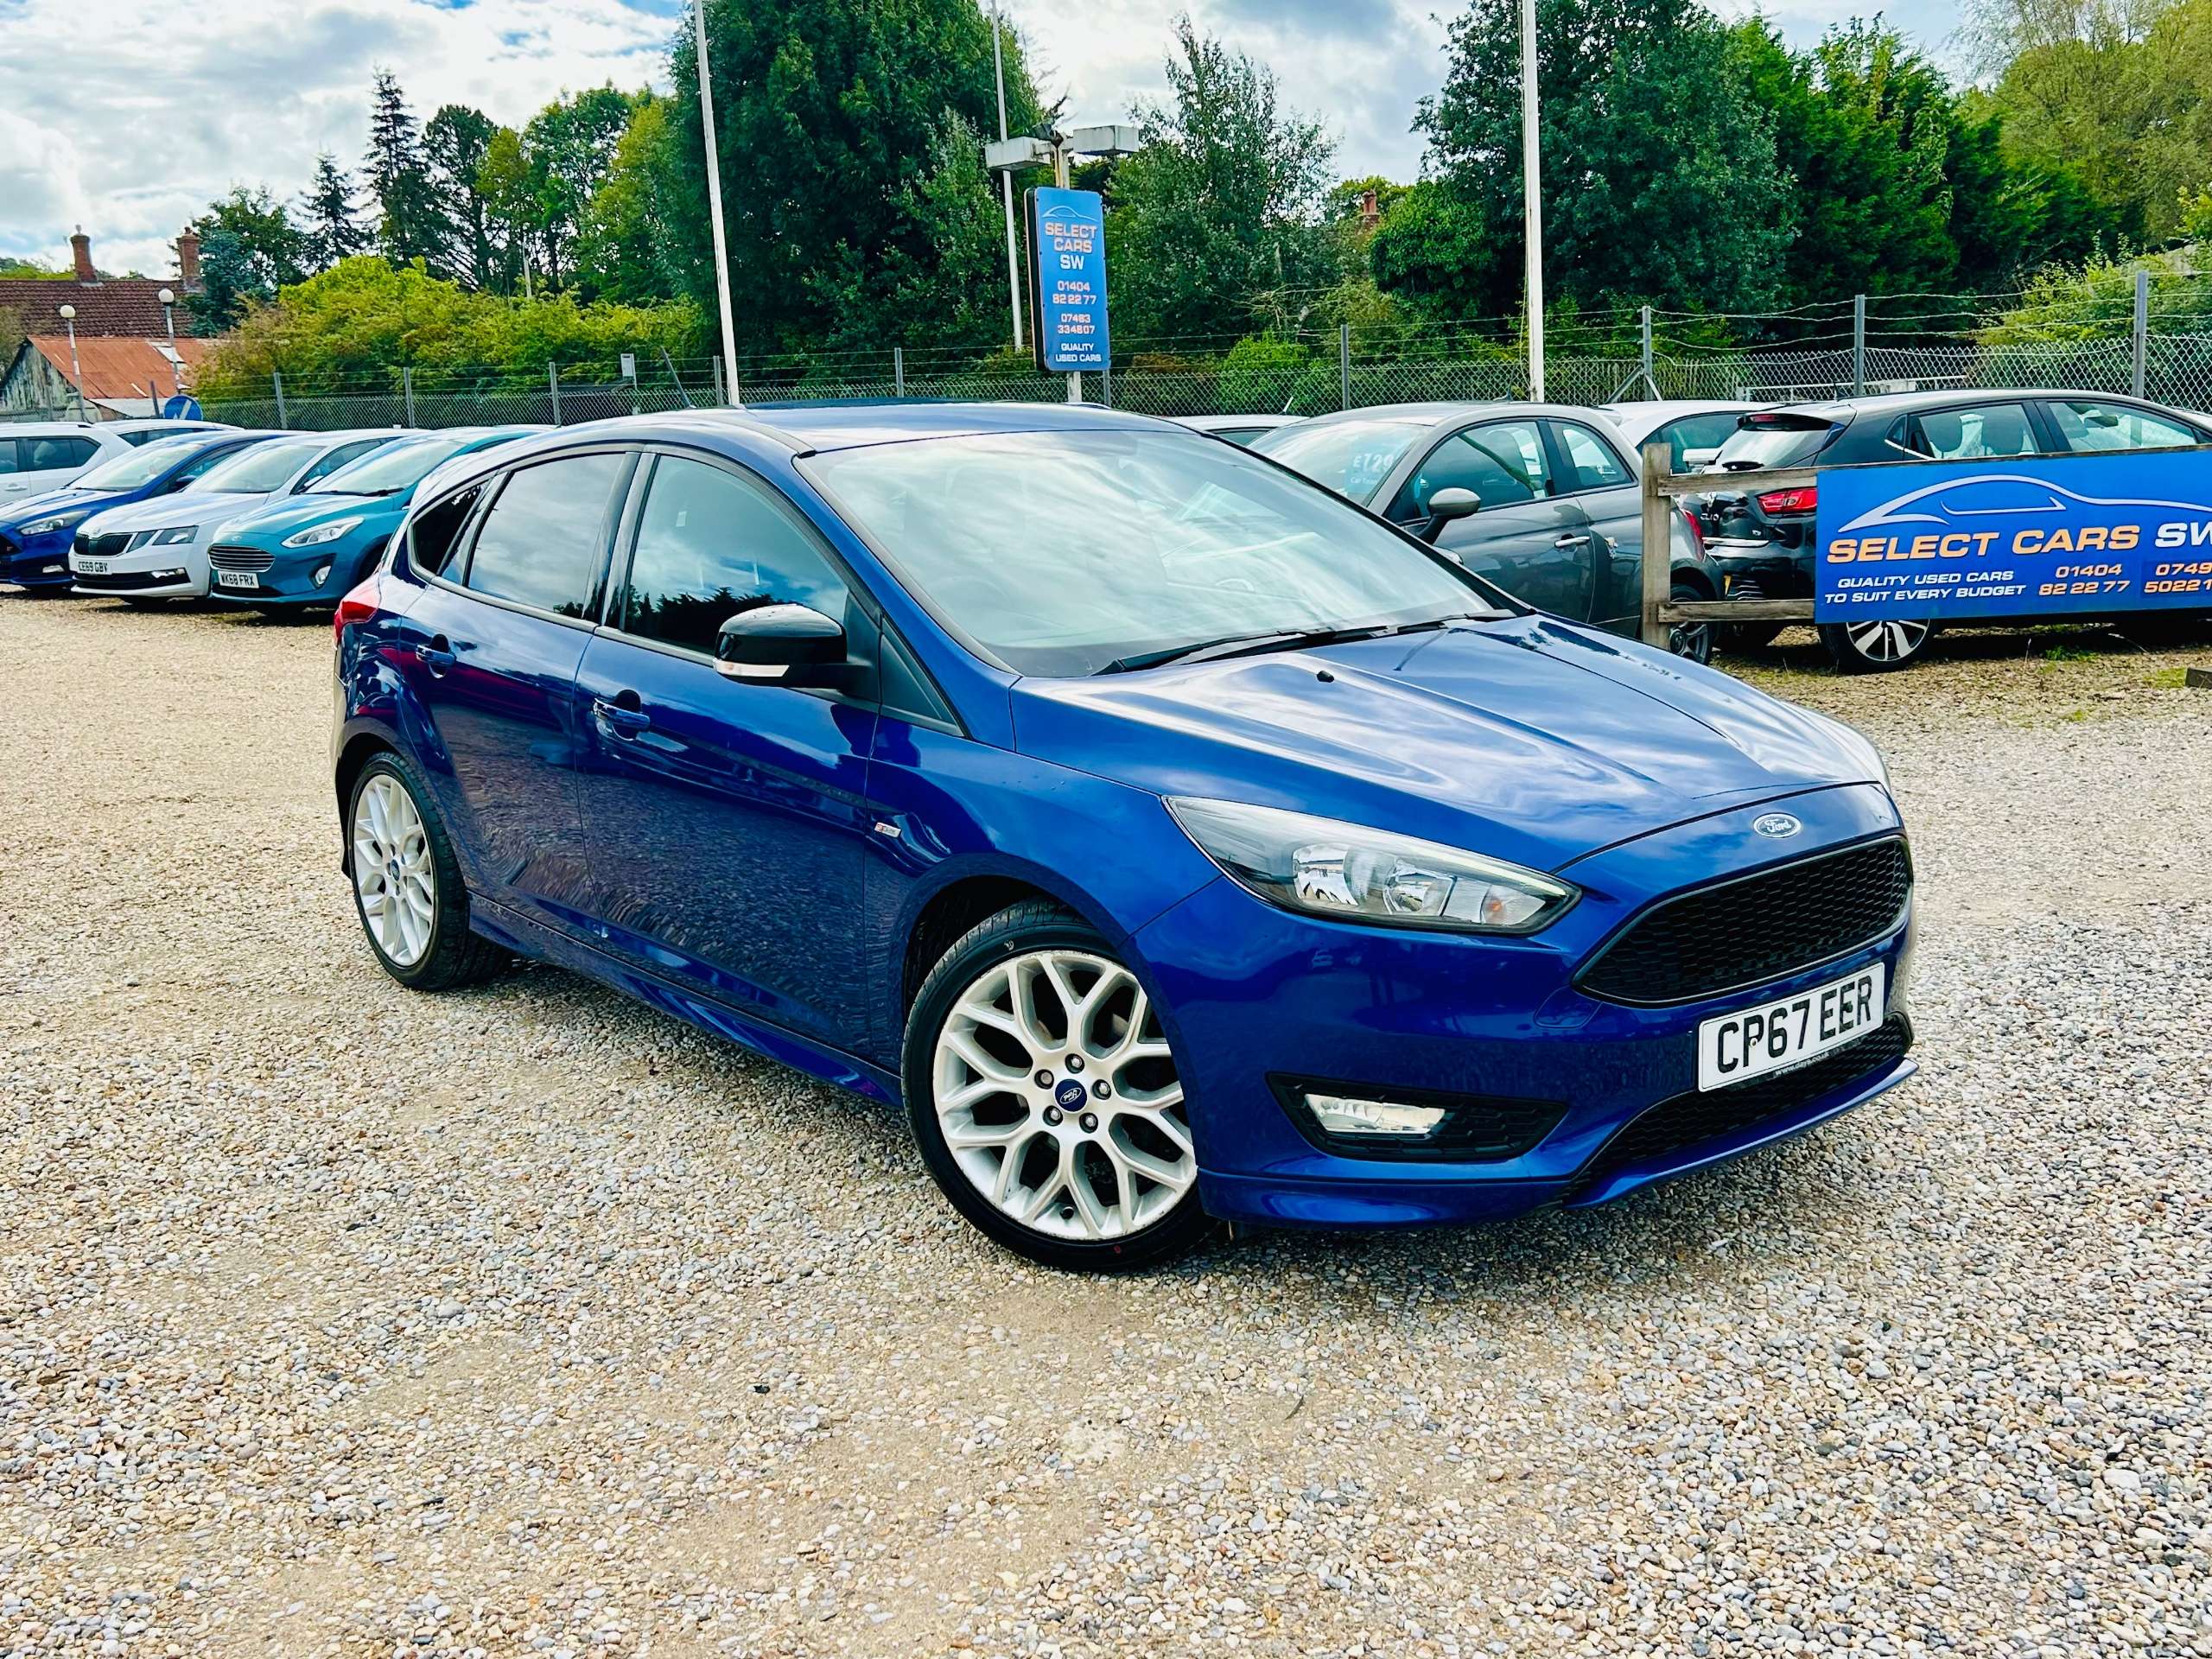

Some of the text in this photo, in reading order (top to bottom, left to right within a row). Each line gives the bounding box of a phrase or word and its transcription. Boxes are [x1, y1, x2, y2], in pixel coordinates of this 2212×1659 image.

[1045, 222, 1097, 238] SELECT
[1054, 237, 1093, 253] CARS
[1059, 254, 1084, 270] SW
[1057, 280, 1090, 292] 01404
[1060, 342, 1095, 352] QUALITY
[1055, 353, 1102, 362] USED CARS
[1827, 531, 2000, 564] SELECT
[2012, 524, 2141, 556] CARS
[2055, 563, 2123, 579] 01404
[1837, 570, 2015, 589] QUALITY USED CARS
[1824, 584, 2027, 604] TO SUIT EVERY BUDGET
[2038, 580, 2131, 596] 82 22 77
[1717, 975, 1872, 1074] CP67 EER
